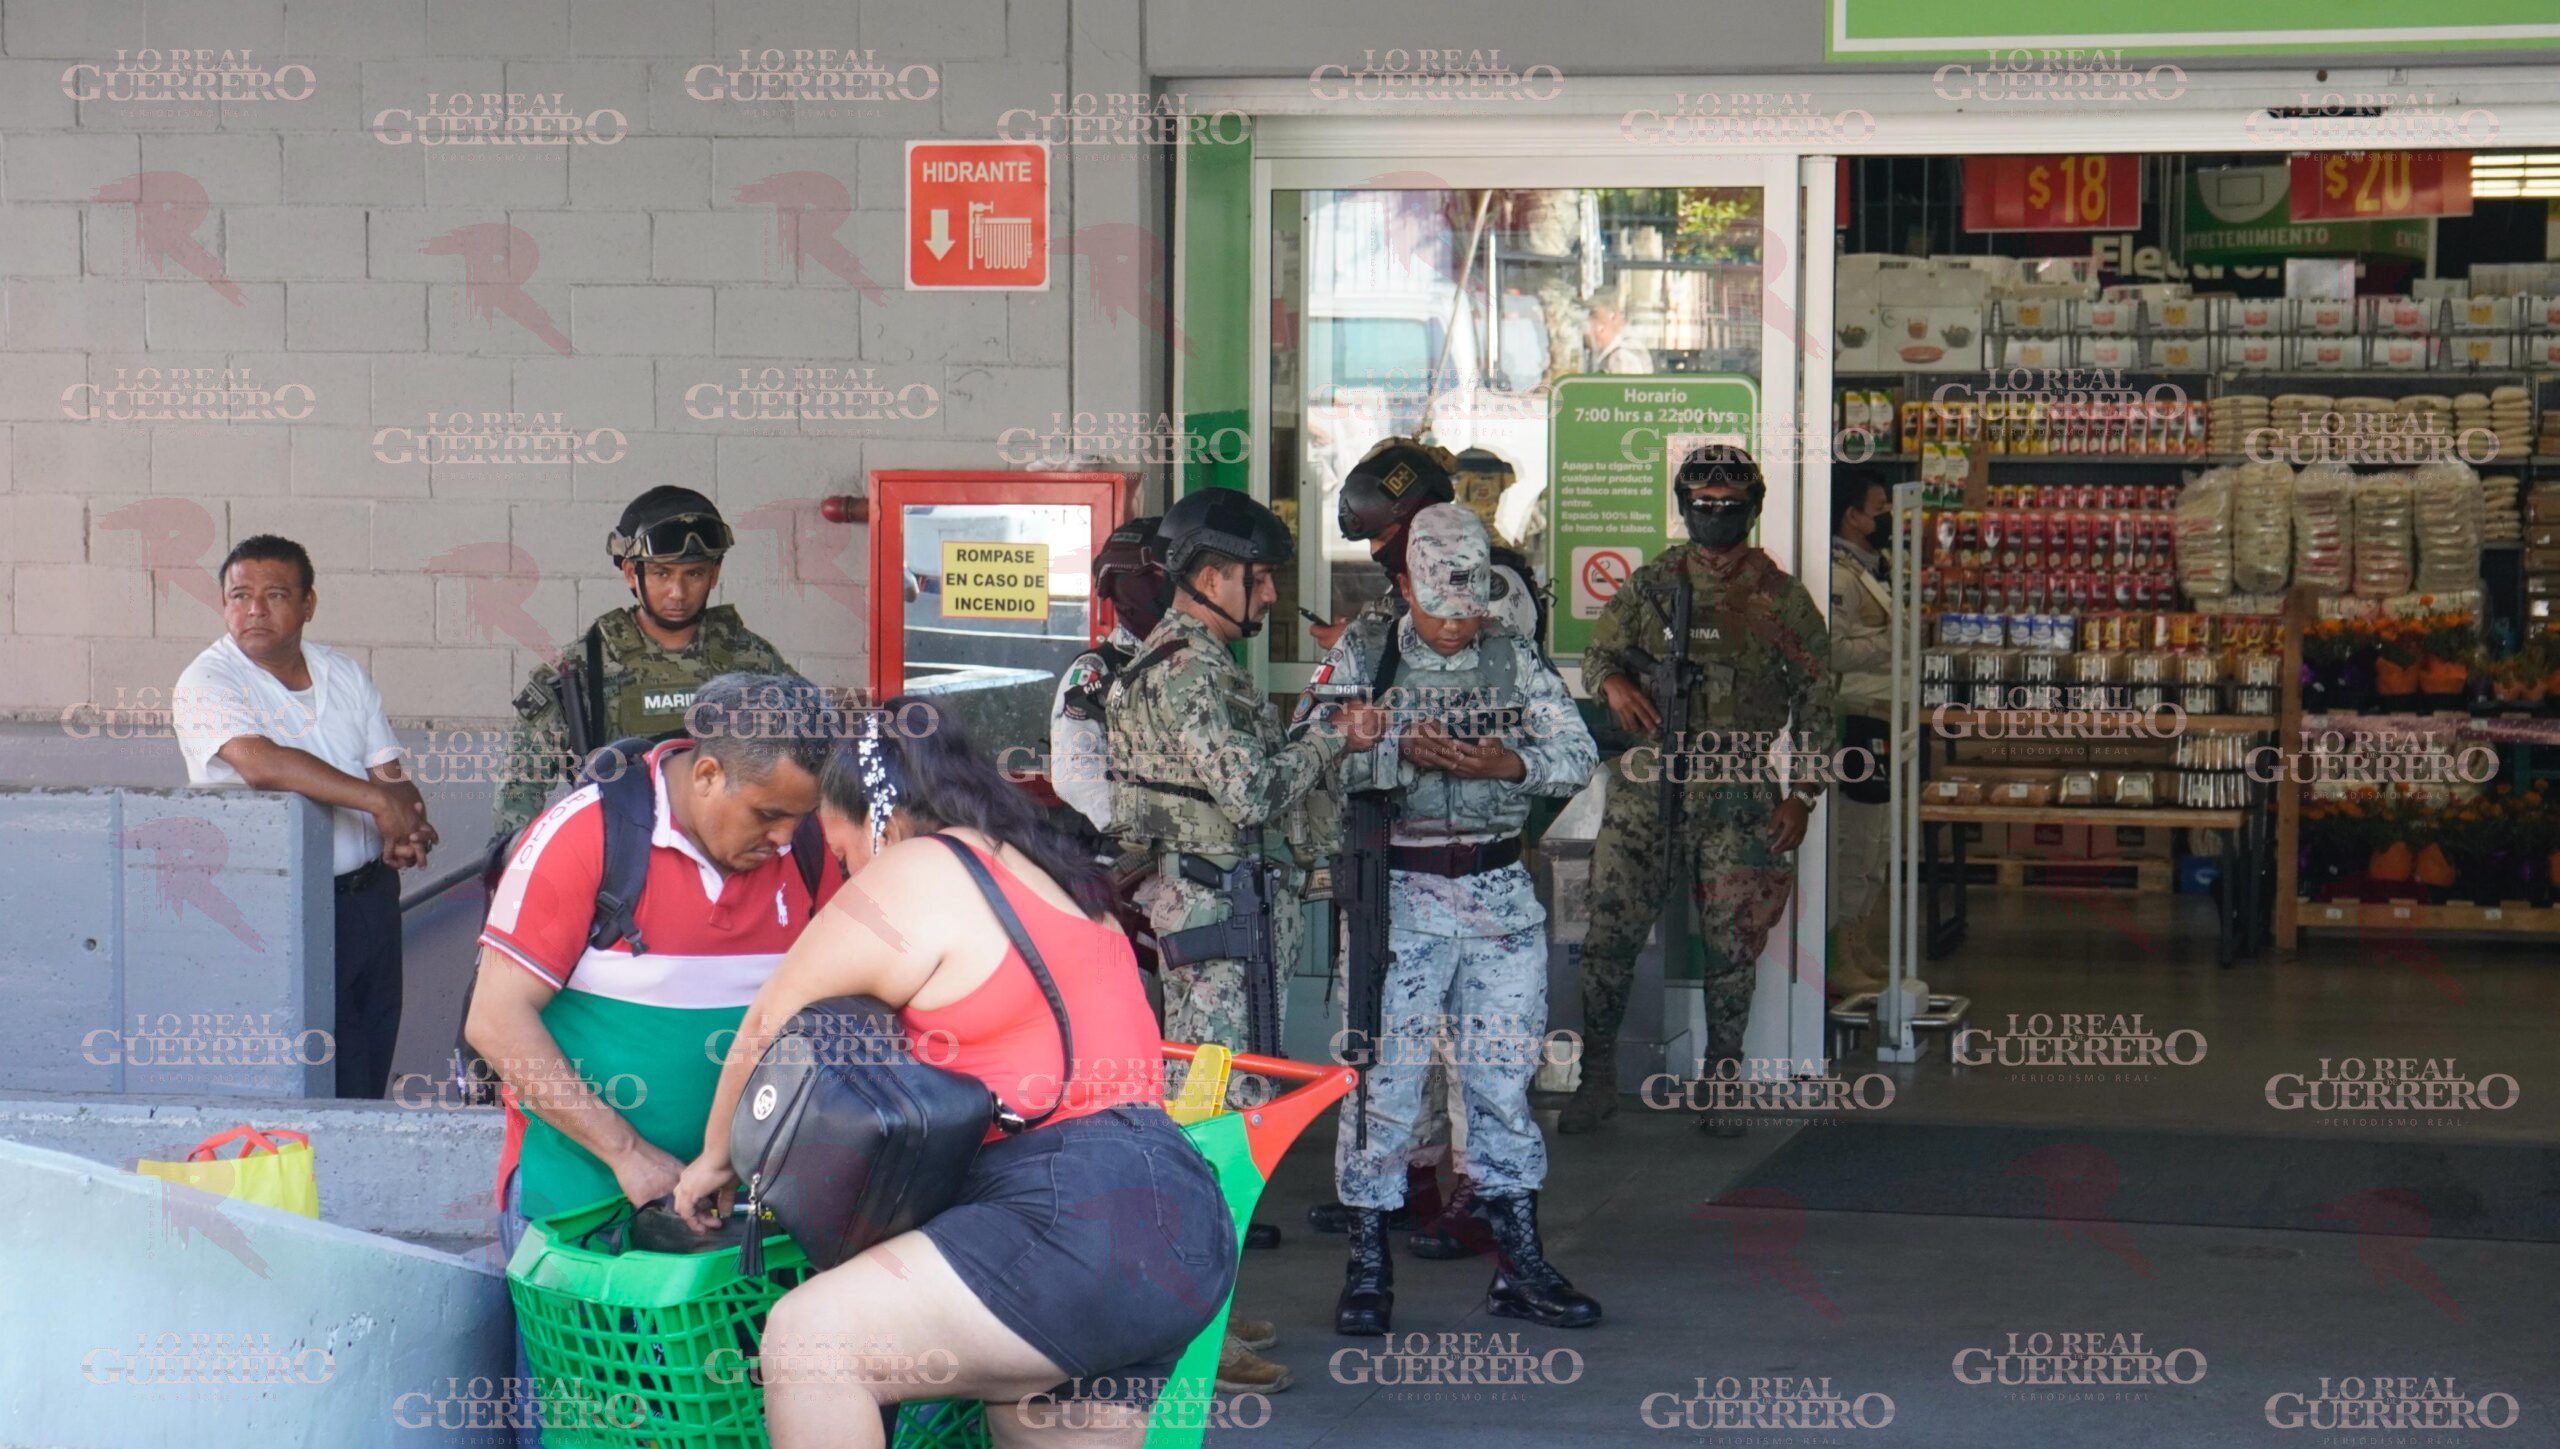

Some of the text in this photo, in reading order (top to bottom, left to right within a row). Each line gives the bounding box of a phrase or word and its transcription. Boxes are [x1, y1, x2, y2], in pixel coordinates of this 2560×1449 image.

[923, 161, 1032, 182] HIDRANTE
[1624, 388, 1687, 403] Horario
[1575, 408, 1735, 423] 7:00 hrs a 22:00 hrs
[1562, 461, 1594, 473] Apaga
[1596, 462, 1607, 471] tu
[1608, 461, 1643, 473] cigarro
[1562, 474, 1654, 485] cualquier producto
[1562, 486, 1653, 496] de tabaco antes de
[1561, 499, 1593, 508] entrar.
[1562, 511, 1652, 522] Espacio 100% libre
[1561, 523, 1656, 533] de humo de tabaco.
[957, 549, 1035, 563] ROMPASE
[946, 573, 1045, 588] EN CASO DE
[955, 598, 1035, 612] INCENDIO
